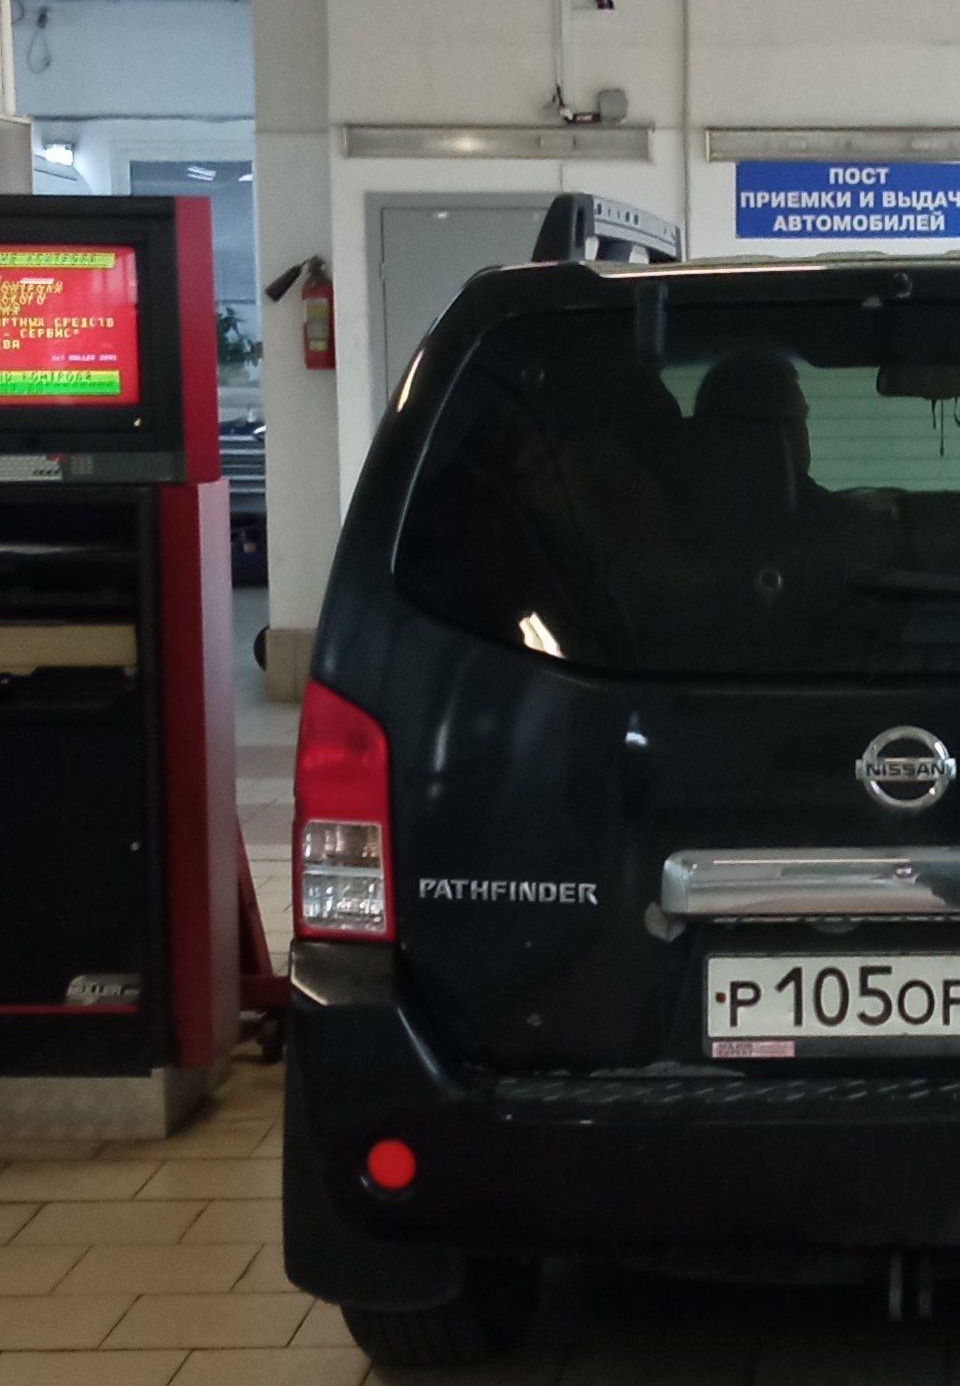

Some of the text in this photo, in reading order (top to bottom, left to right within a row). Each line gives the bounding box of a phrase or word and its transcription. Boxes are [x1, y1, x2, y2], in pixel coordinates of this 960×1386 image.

[828, 167, 890, 185] ПОСТ
[740, 191, 851, 209] ПРИЕМКИ
[858, 191, 875, 208] И
[772, 211, 946, 232] АВТОМОБИЛЕЙ
[866, 763, 946, 777] NISSAN
[418, 877, 599, 906] PATHFINDER
